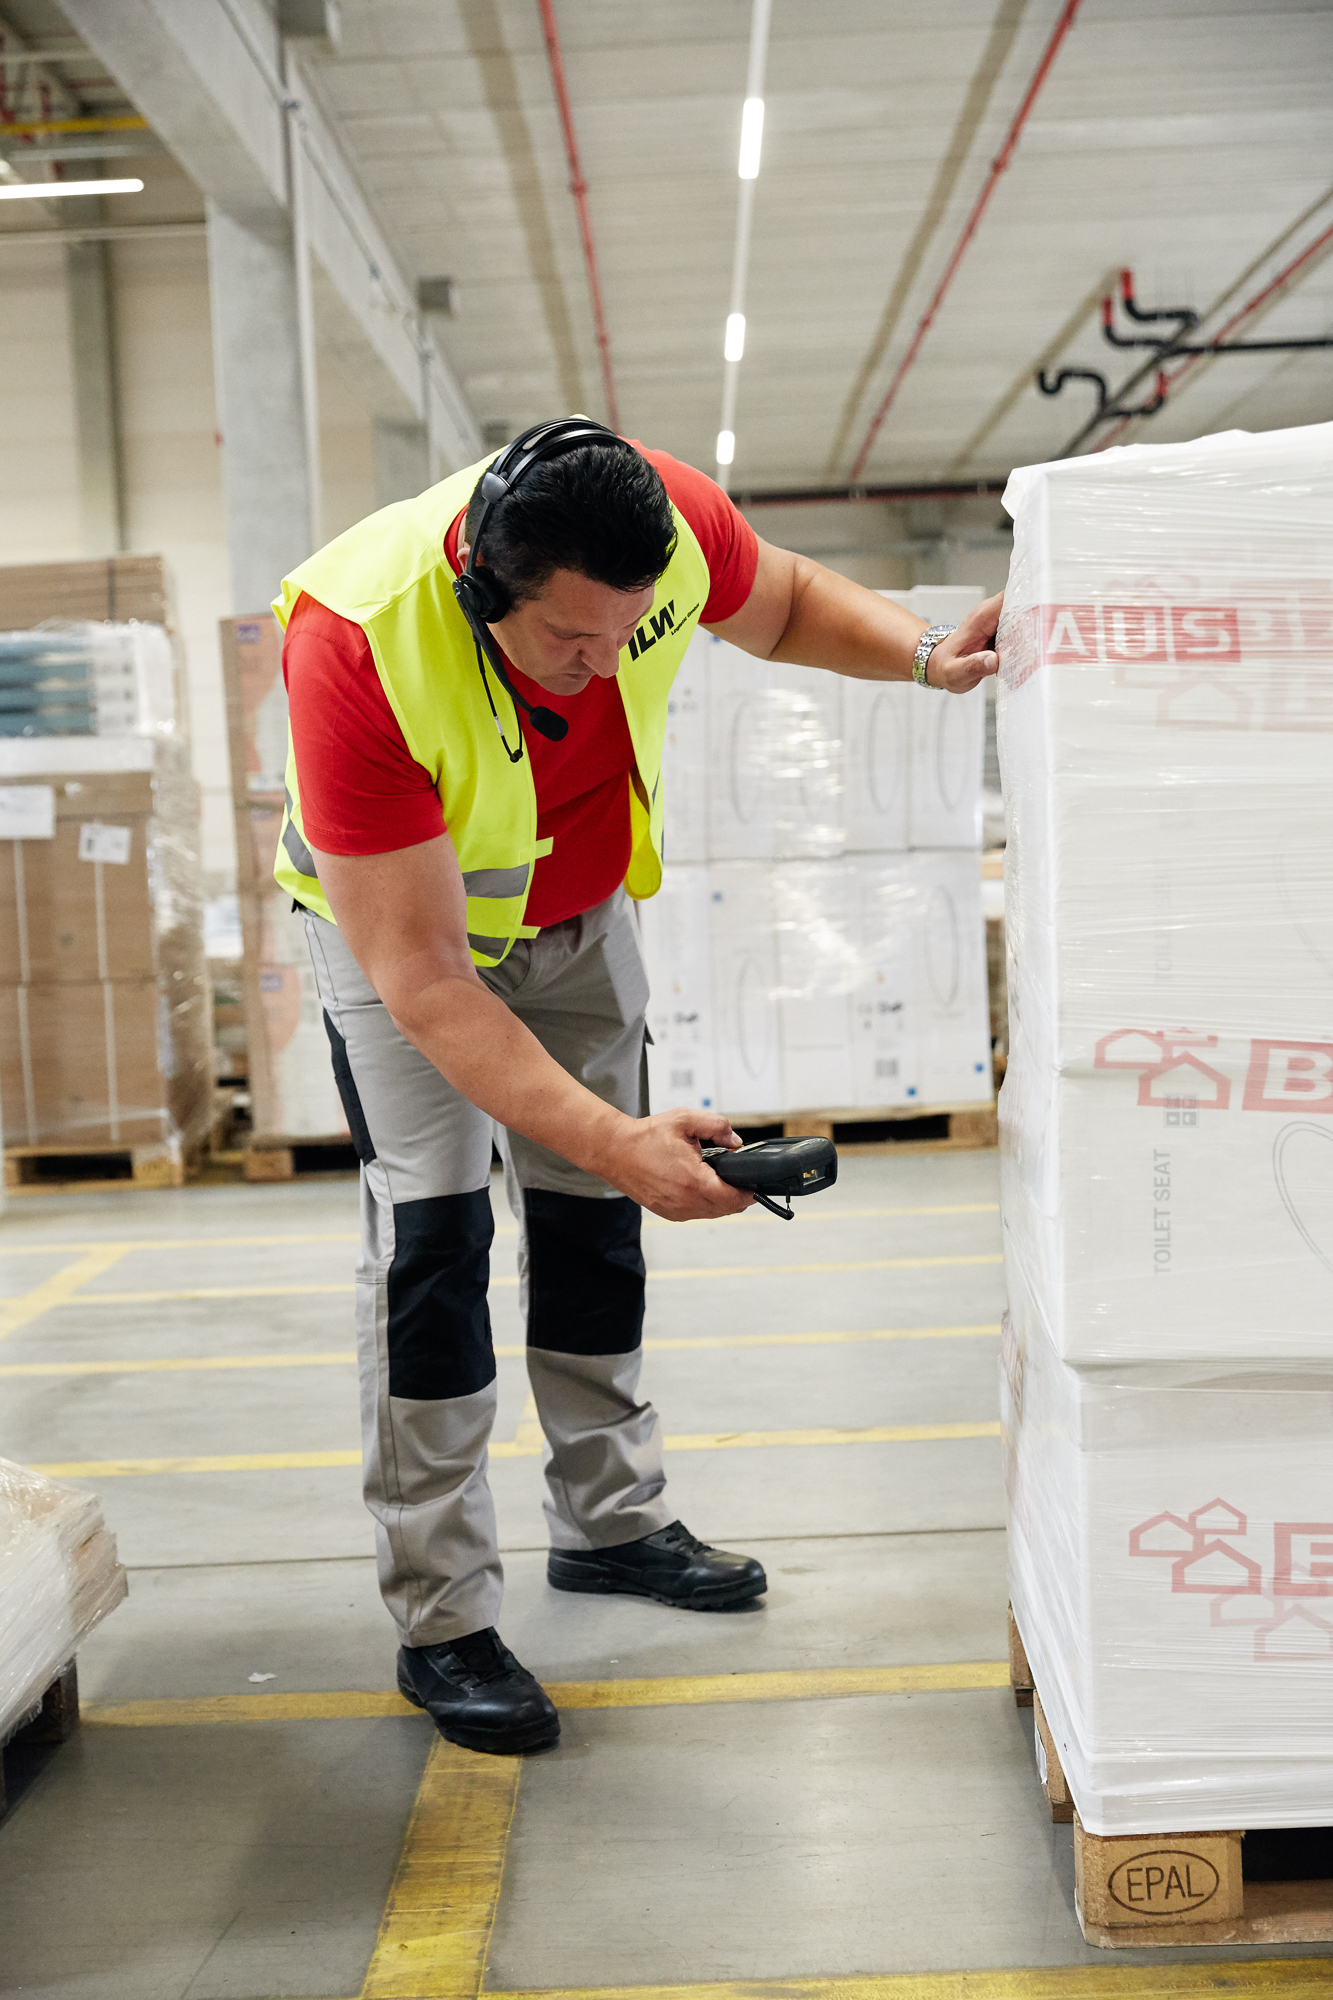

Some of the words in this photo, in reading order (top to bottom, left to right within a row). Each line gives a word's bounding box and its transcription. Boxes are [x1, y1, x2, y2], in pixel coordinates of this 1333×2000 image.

[1153, 1148, 1171, 1203] SEAT
[1153, 1207, 1171, 1273] TOILET
[1125, 1864, 1204, 1903] EPAL
